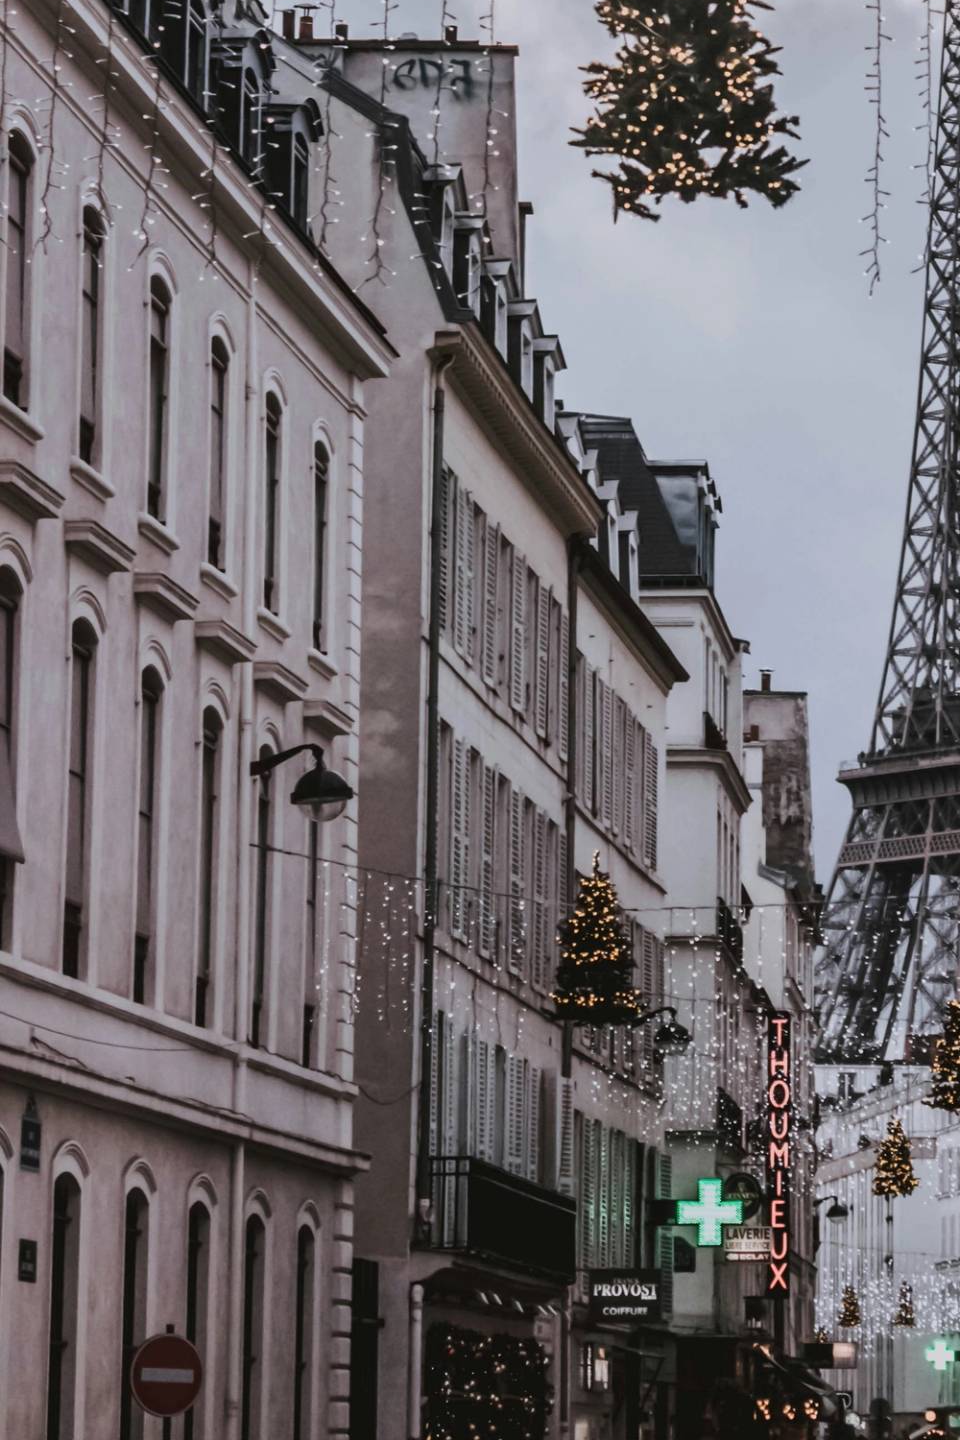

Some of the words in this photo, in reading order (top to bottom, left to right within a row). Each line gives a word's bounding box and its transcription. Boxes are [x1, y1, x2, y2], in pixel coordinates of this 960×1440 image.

[768, 1018, 790, 1290] THOUMIEUX
[726, 1228, 770, 1240] LAVERIE
[593, 1283, 658, 1296] PROVOST
